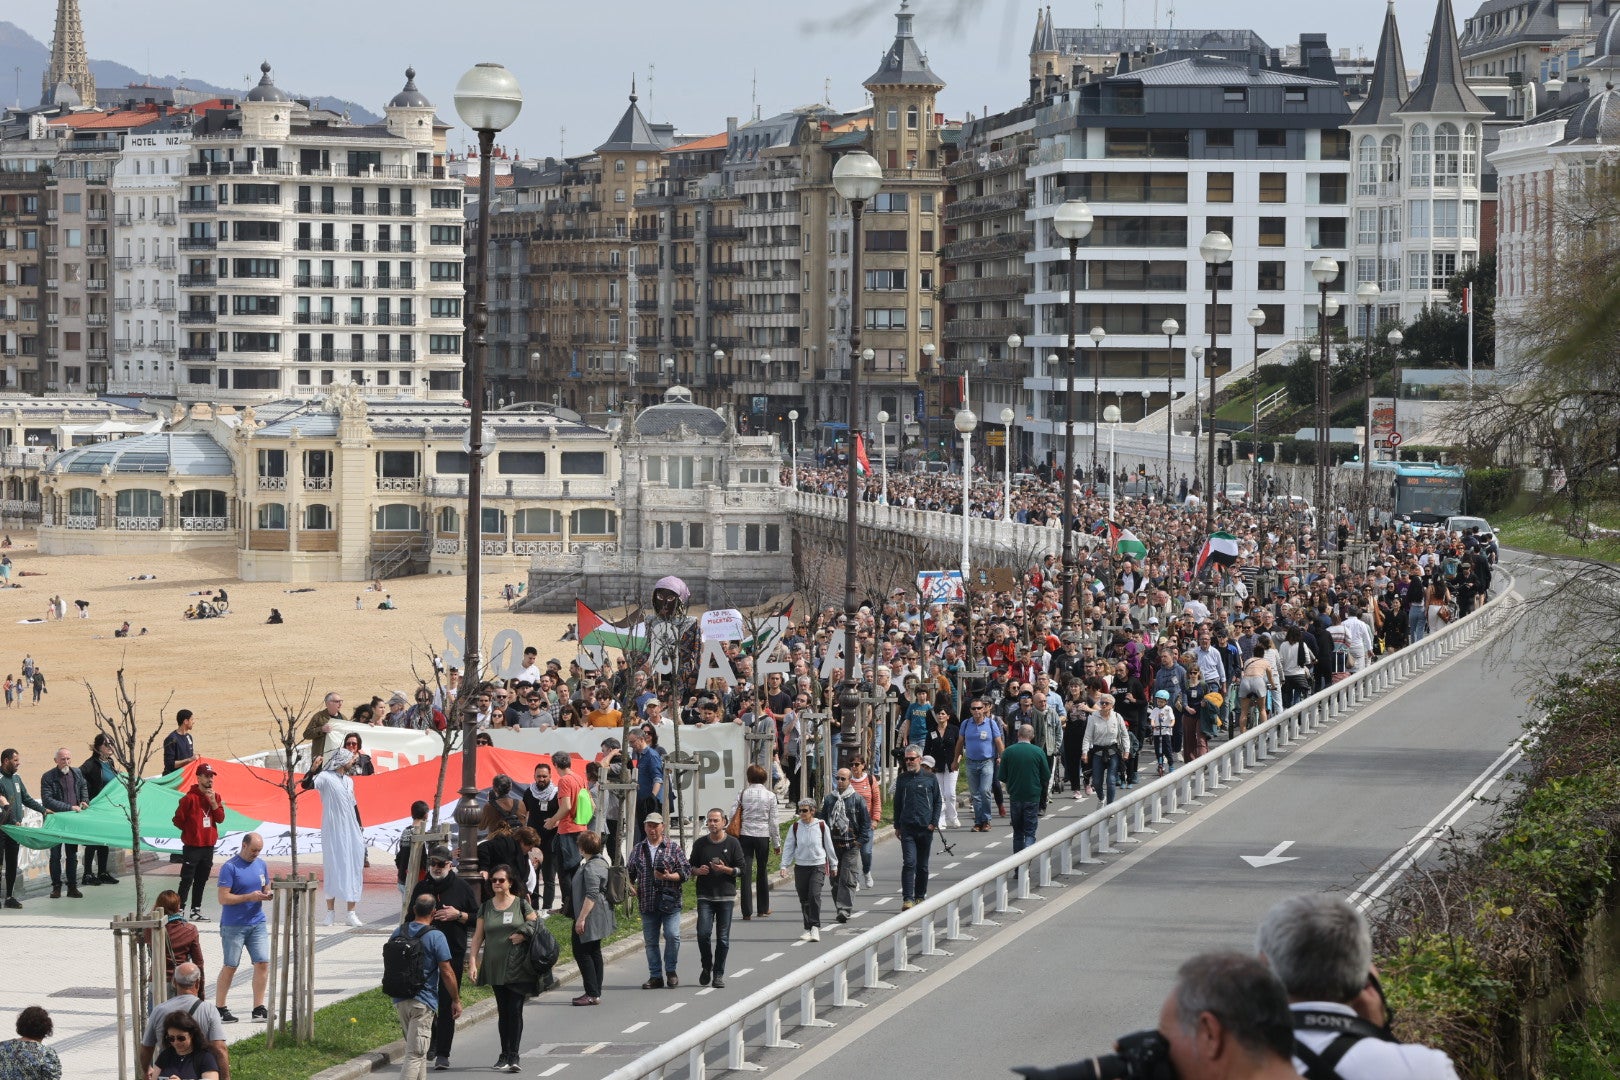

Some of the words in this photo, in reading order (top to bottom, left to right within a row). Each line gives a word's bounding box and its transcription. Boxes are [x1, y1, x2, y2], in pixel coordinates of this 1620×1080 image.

[132, 138, 156, 146] HOTEL
[166, 137, 182, 146] NIZ
[1304, 1014, 1351, 1029] SONY
